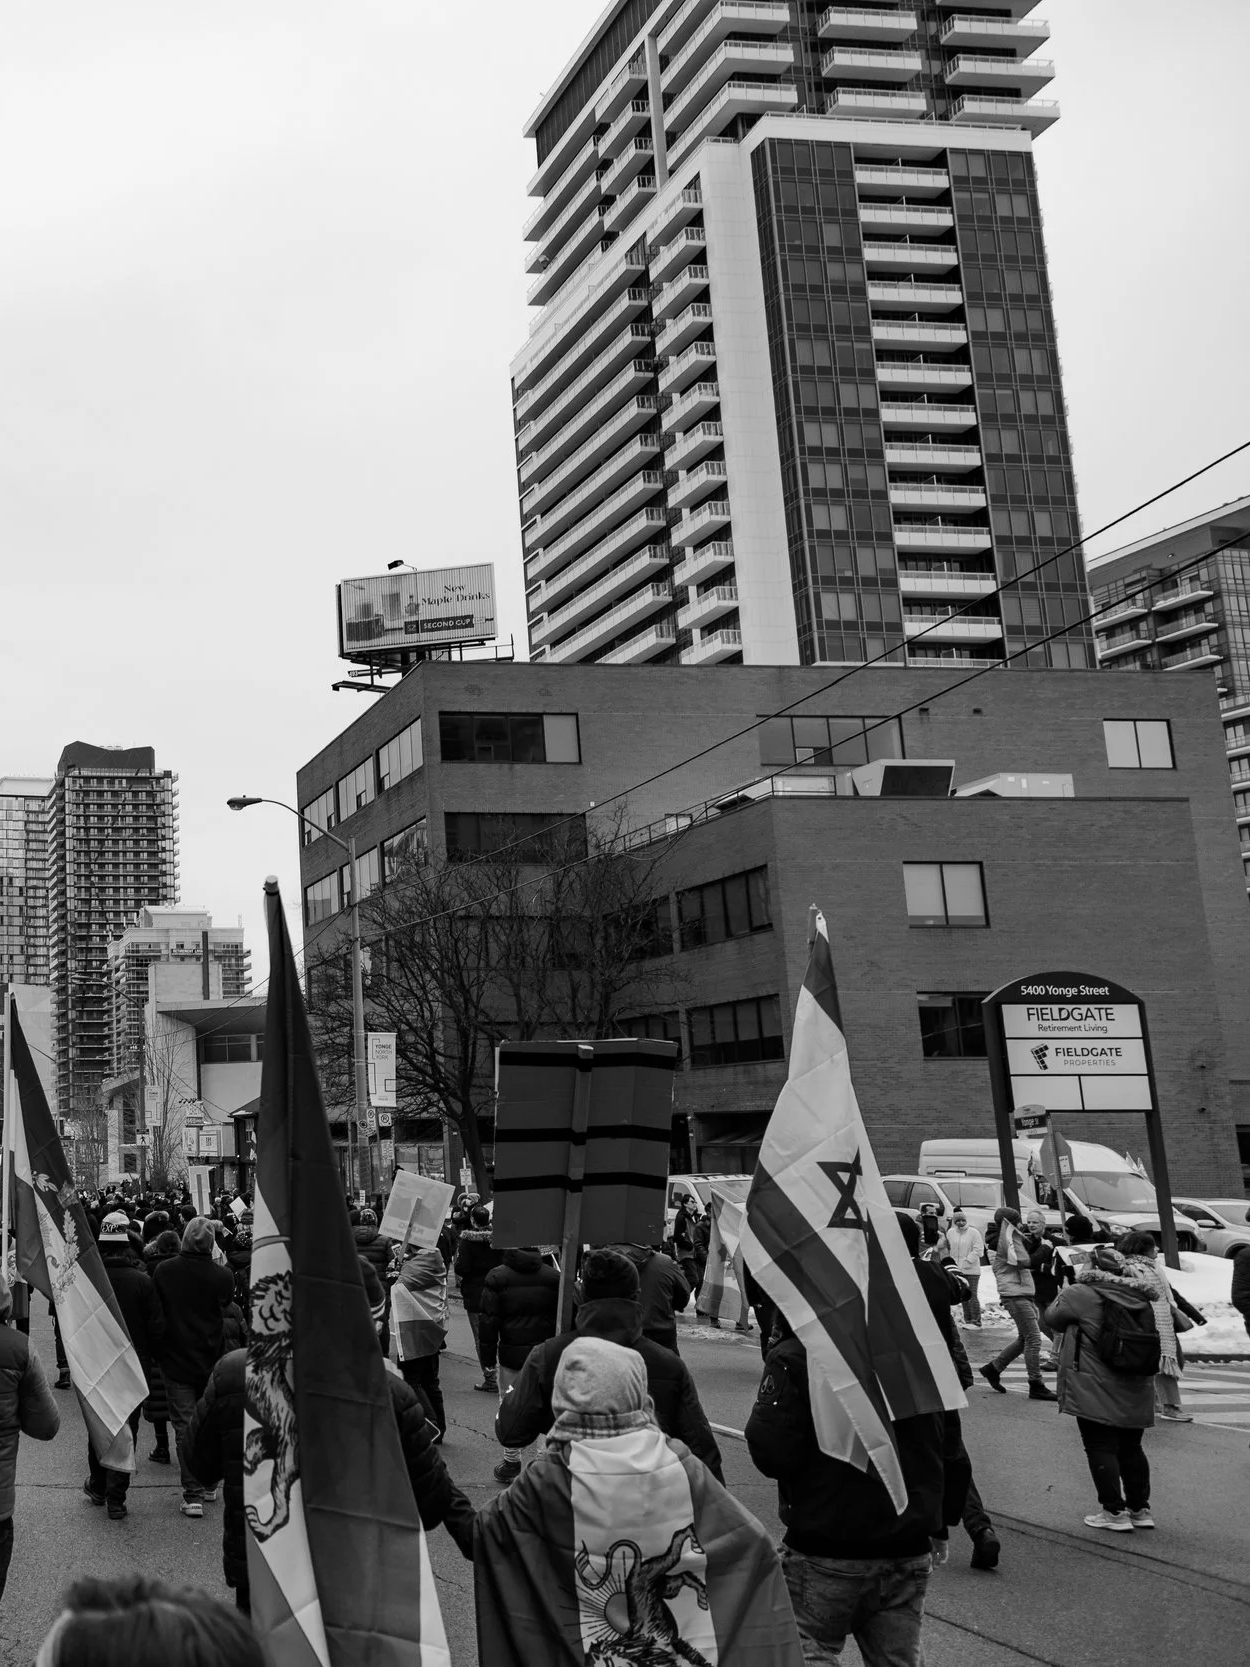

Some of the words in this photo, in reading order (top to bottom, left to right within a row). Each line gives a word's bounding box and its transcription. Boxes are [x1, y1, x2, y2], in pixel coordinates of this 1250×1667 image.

[444, 584, 465, 593] New
[422, 596, 452, 606] Maple
[456, 592, 490, 602] Drinks
[423, 620, 454, 629] SECOND
[1021, 985, 1046, 996] 5400
[1046, 985, 1079, 998] Yonge
[1079, 985, 1110, 996] Street
[1026, 1007, 1116, 1021] FIELDGATE
[1037, 1023, 1082, 1032] Retirement
[1083, 1024, 1108, 1033] Living
[1055, 1047, 1123, 1057] FIELDGATE
